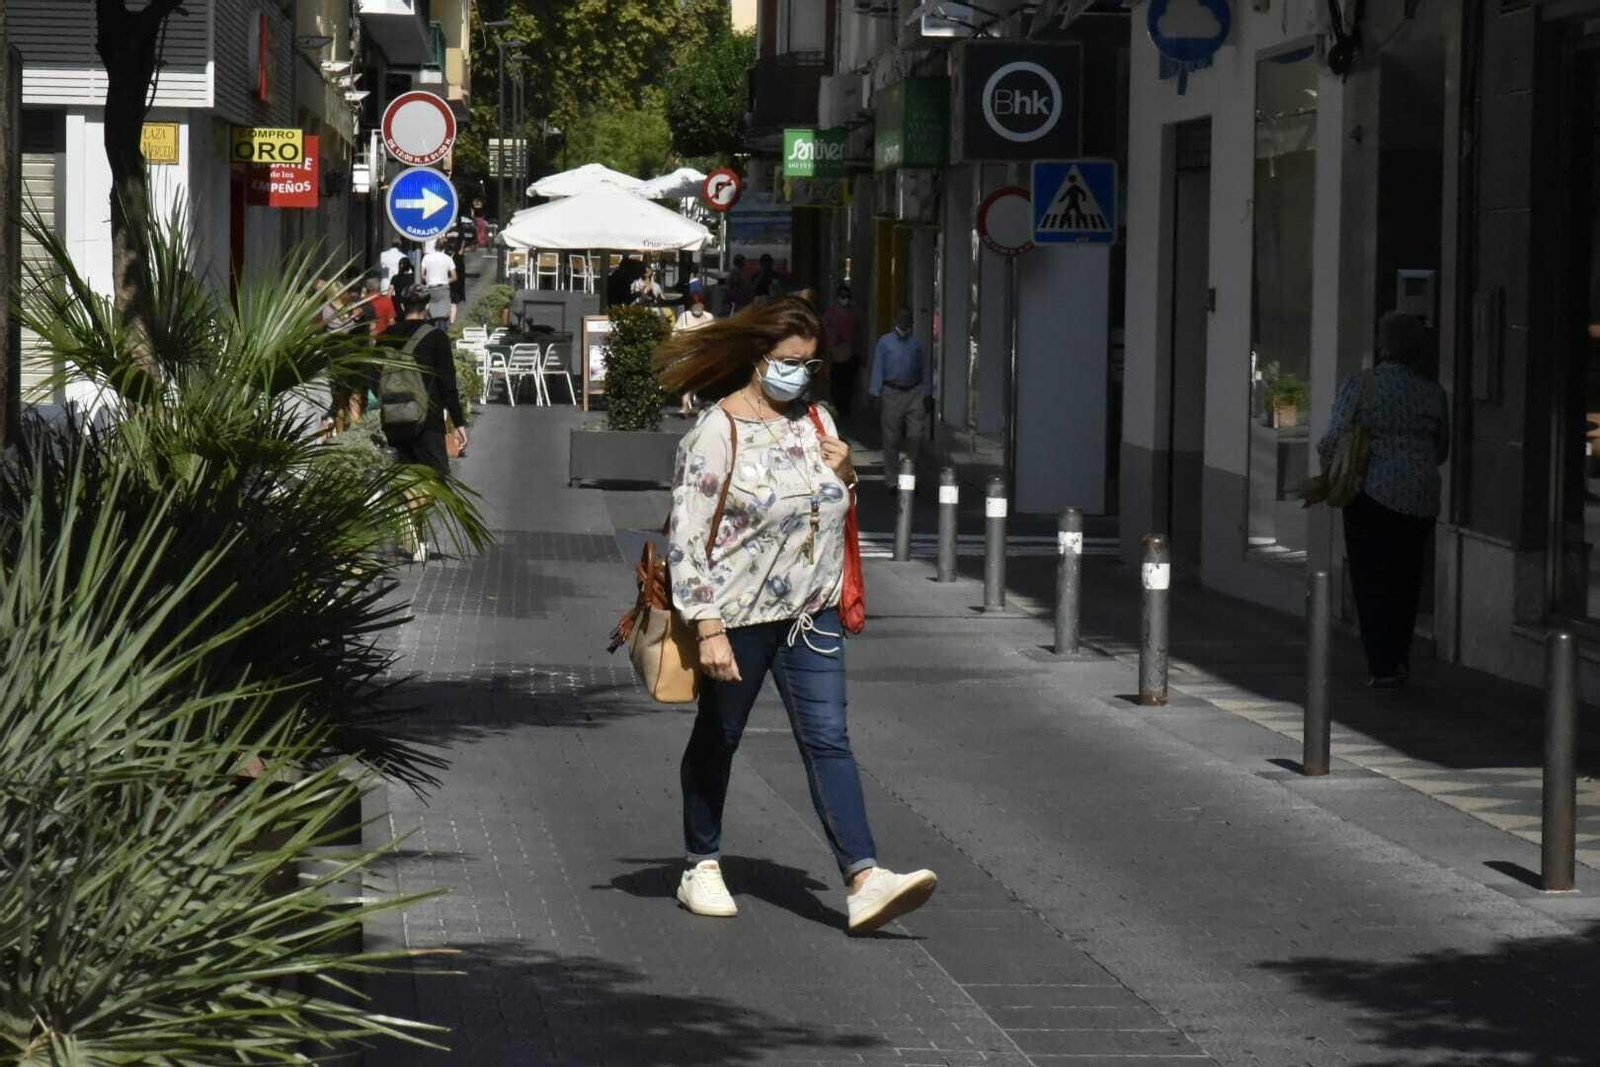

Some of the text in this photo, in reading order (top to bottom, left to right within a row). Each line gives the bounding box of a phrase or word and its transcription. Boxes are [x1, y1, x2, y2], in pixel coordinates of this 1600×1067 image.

[994, 88, 1051, 115] Bhk
[143, 127, 167, 140] LAZA
[237, 130, 295, 140] COMPRO
[236, 141, 299, 161] ORO
[269, 171, 295, 179] de los
[252, 180, 312, 194] EMPEÑOS
[406, 225, 440, 236] GARAJES
